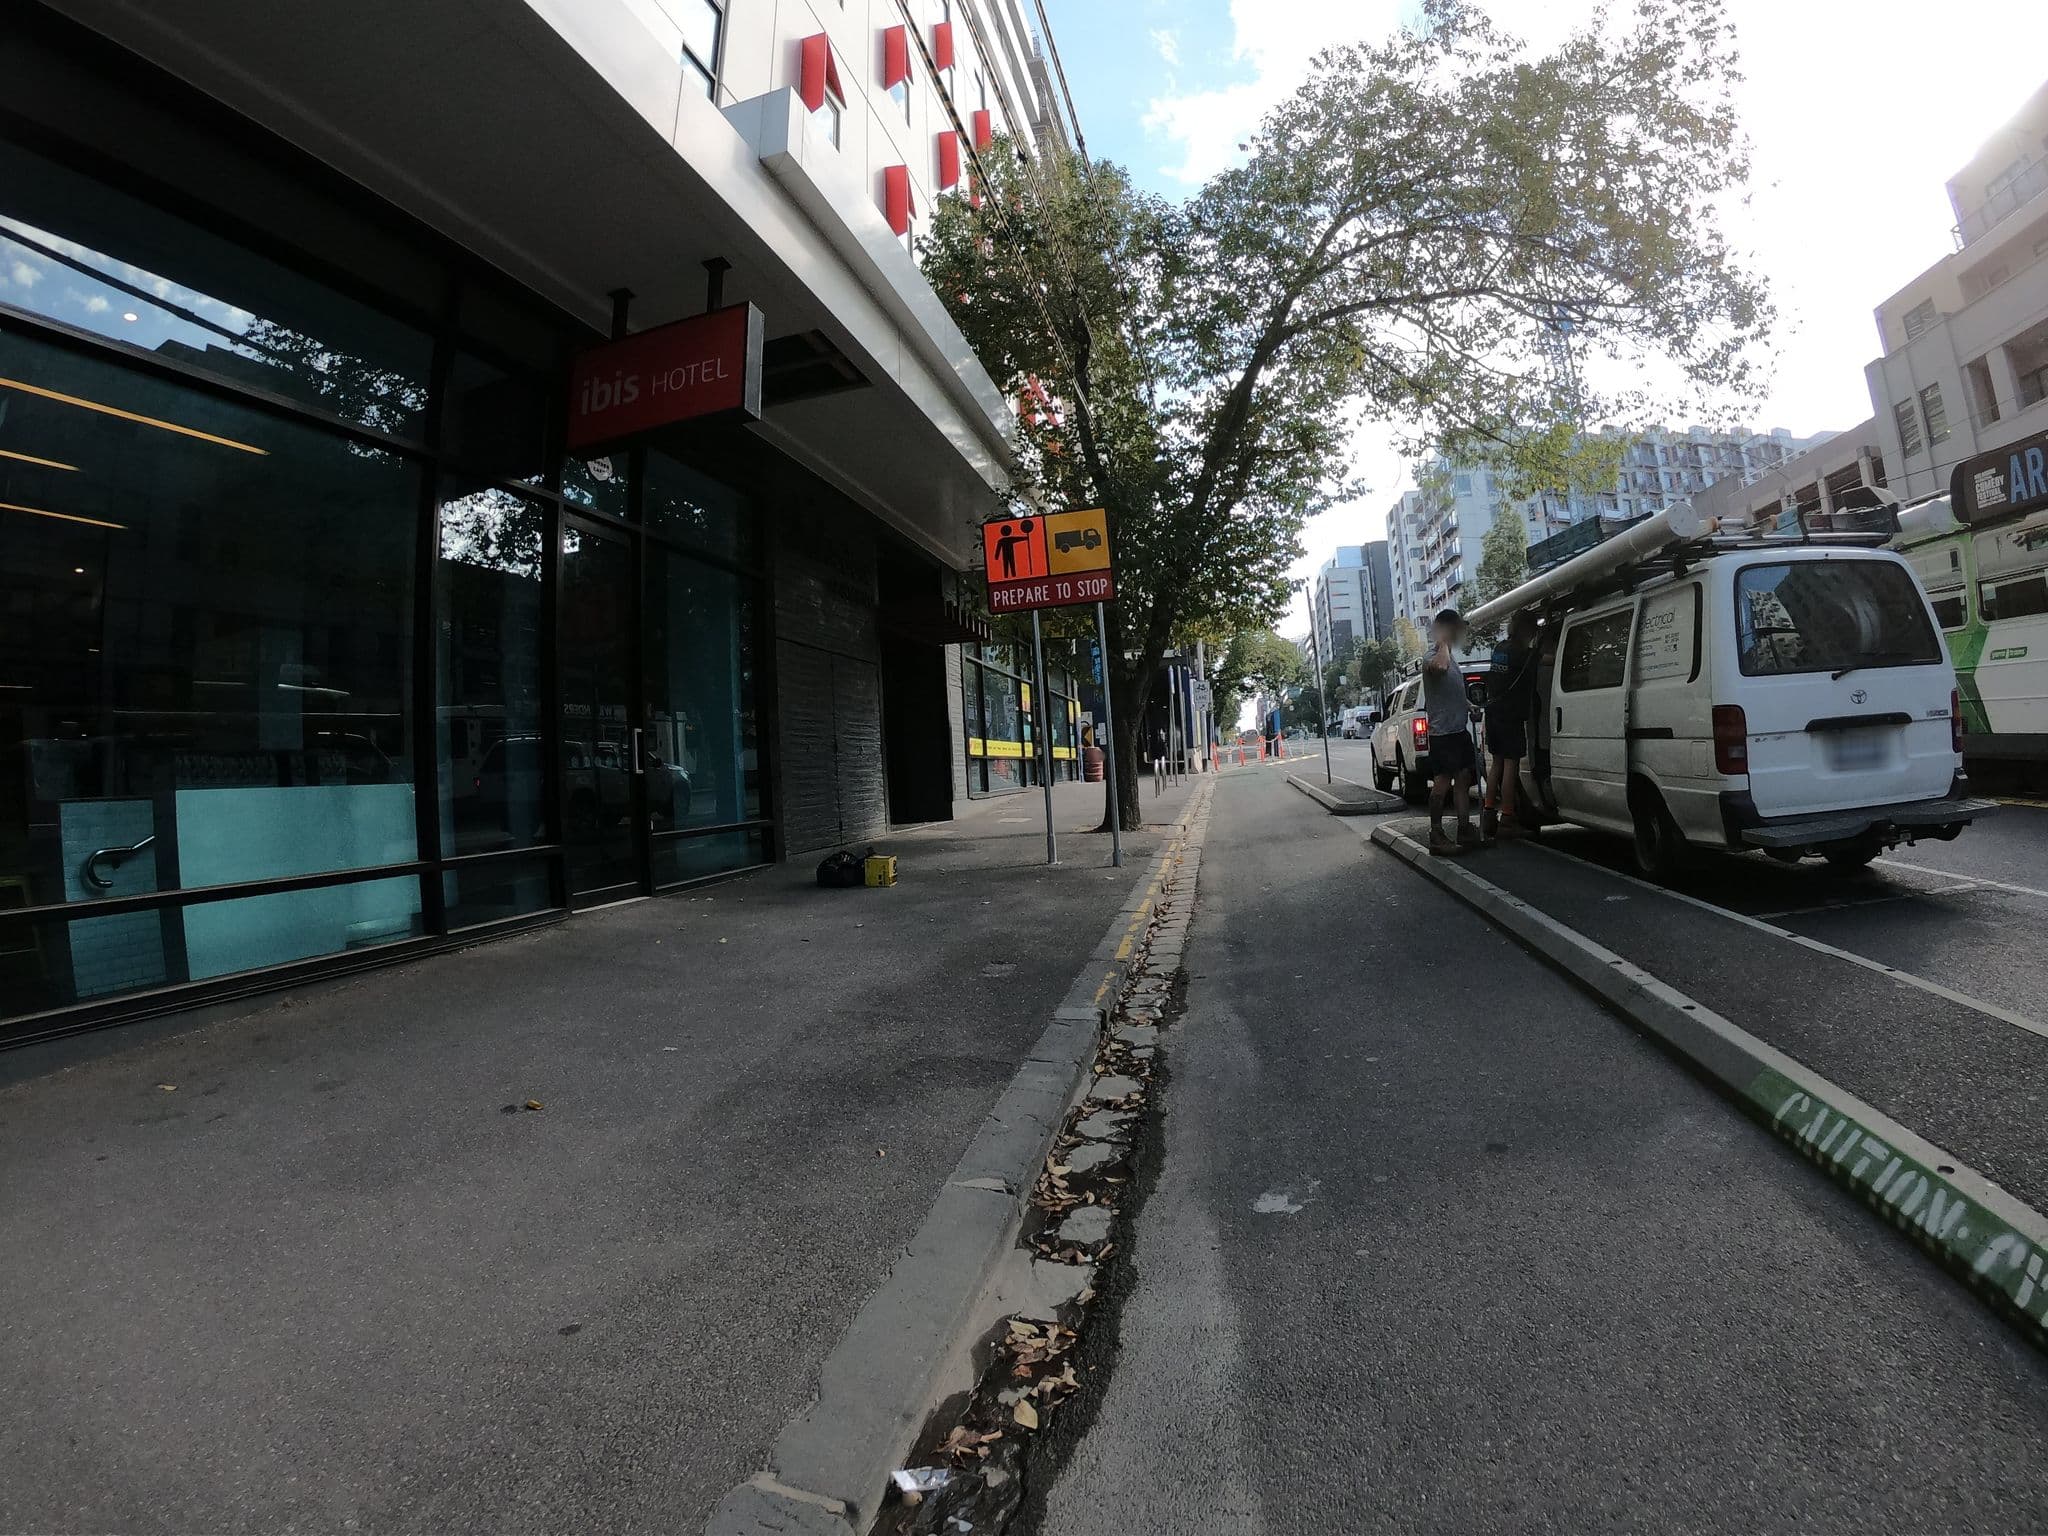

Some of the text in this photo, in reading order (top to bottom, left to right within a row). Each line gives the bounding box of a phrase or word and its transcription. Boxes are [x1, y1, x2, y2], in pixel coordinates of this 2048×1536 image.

[580, 357, 729, 416] ibis HOTEL
[1976, 474, 2004, 493] COMEDY
[993, 578, 1108, 608] PREPARE TO STOP
